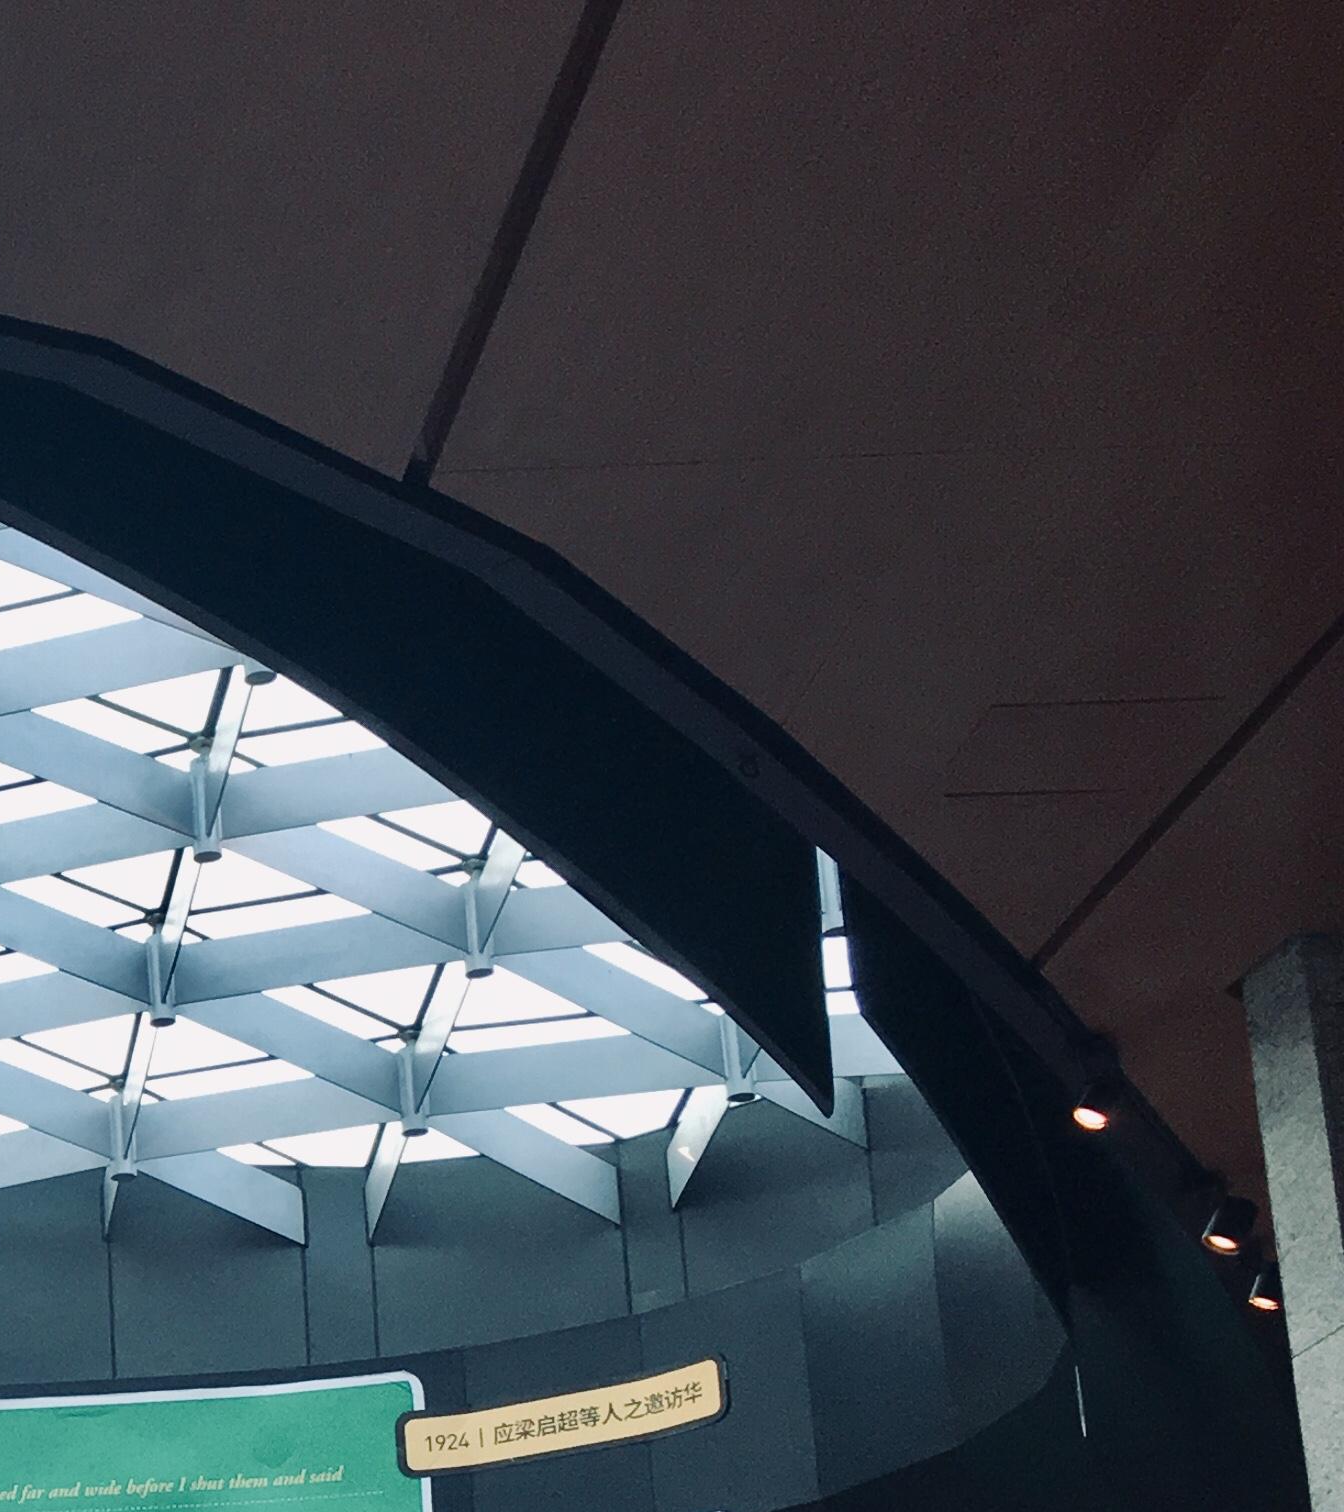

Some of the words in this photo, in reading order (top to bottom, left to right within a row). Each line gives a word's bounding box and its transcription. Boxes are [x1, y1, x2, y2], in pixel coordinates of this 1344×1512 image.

[425, 1433, 469, 1452] 1924
[495, 1382, 702, 1445] 应梁启超等人之邀访华
[17, 1483, 45, 1504] far
[47, 1481, 81, 1499] and
[83, 1479, 122, 1496] wide
[125, 1477, 174, 1498] before
[178, 1476, 186, 1491] I
[189, 1474, 224, 1490] shut
[228, 1473, 269, 1489] them
[271, 1468, 306, 1486] and
[308, 1464, 344, 1483] said
